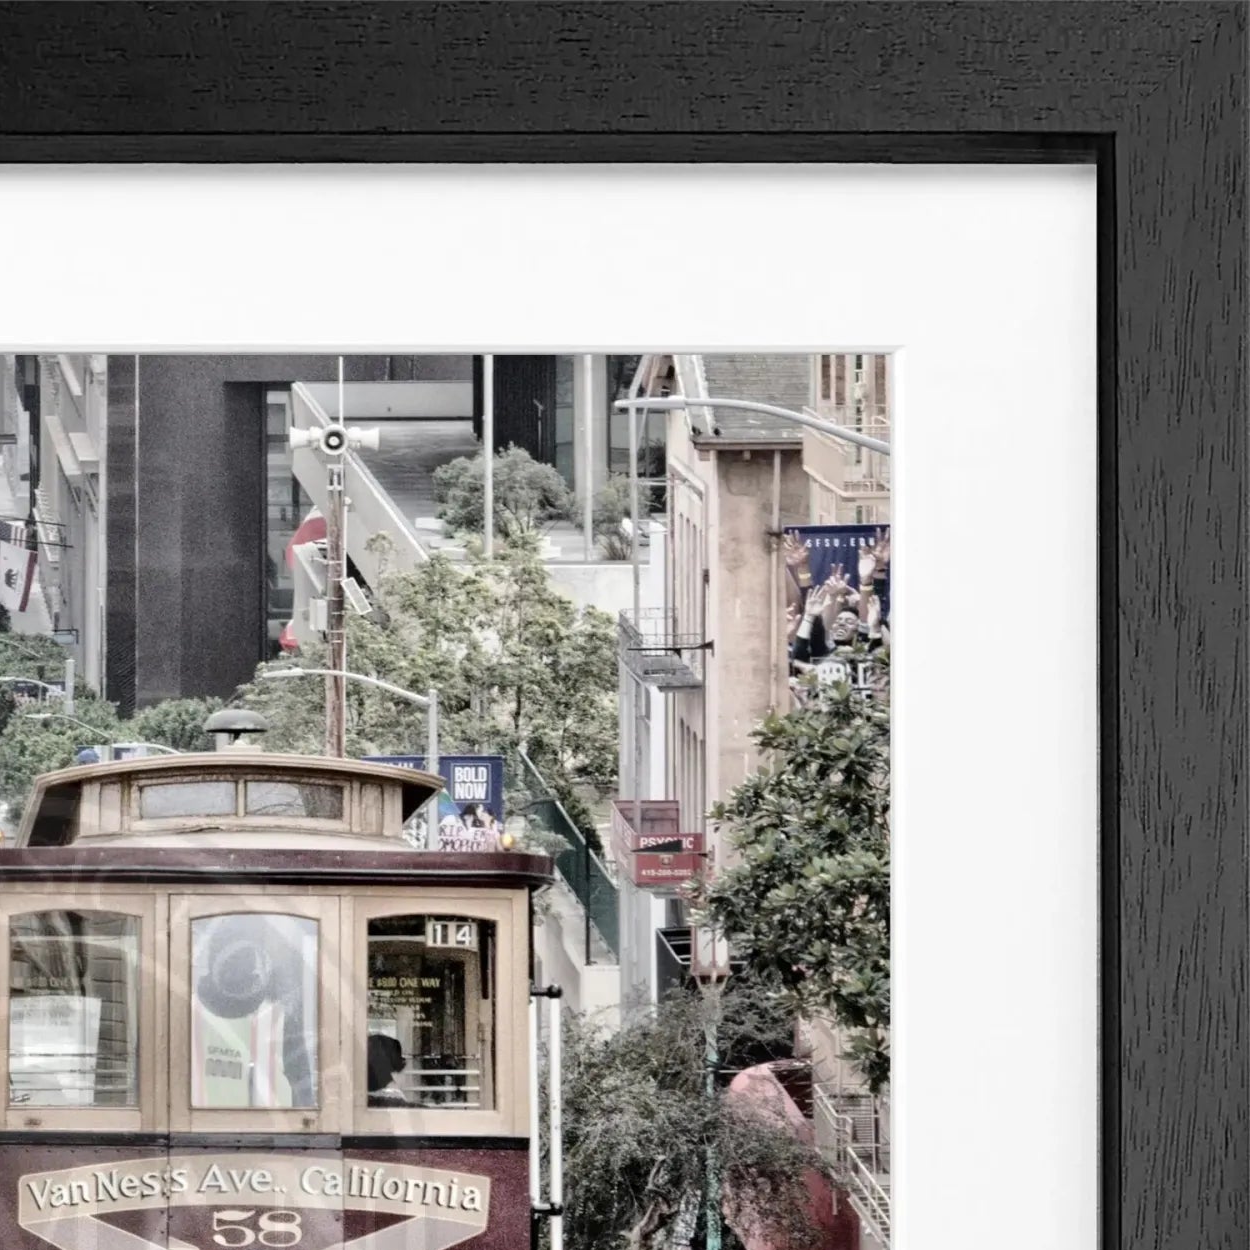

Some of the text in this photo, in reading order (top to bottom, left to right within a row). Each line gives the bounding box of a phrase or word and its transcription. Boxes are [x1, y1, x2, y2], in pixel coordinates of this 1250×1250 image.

[454, 766, 488, 783] BOLD
[454, 783, 488, 800] NOW
[421, 977, 441, 989] WAY
[301, 1165, 483, 1213] California
[213, 1210, 303, 1247] 58
